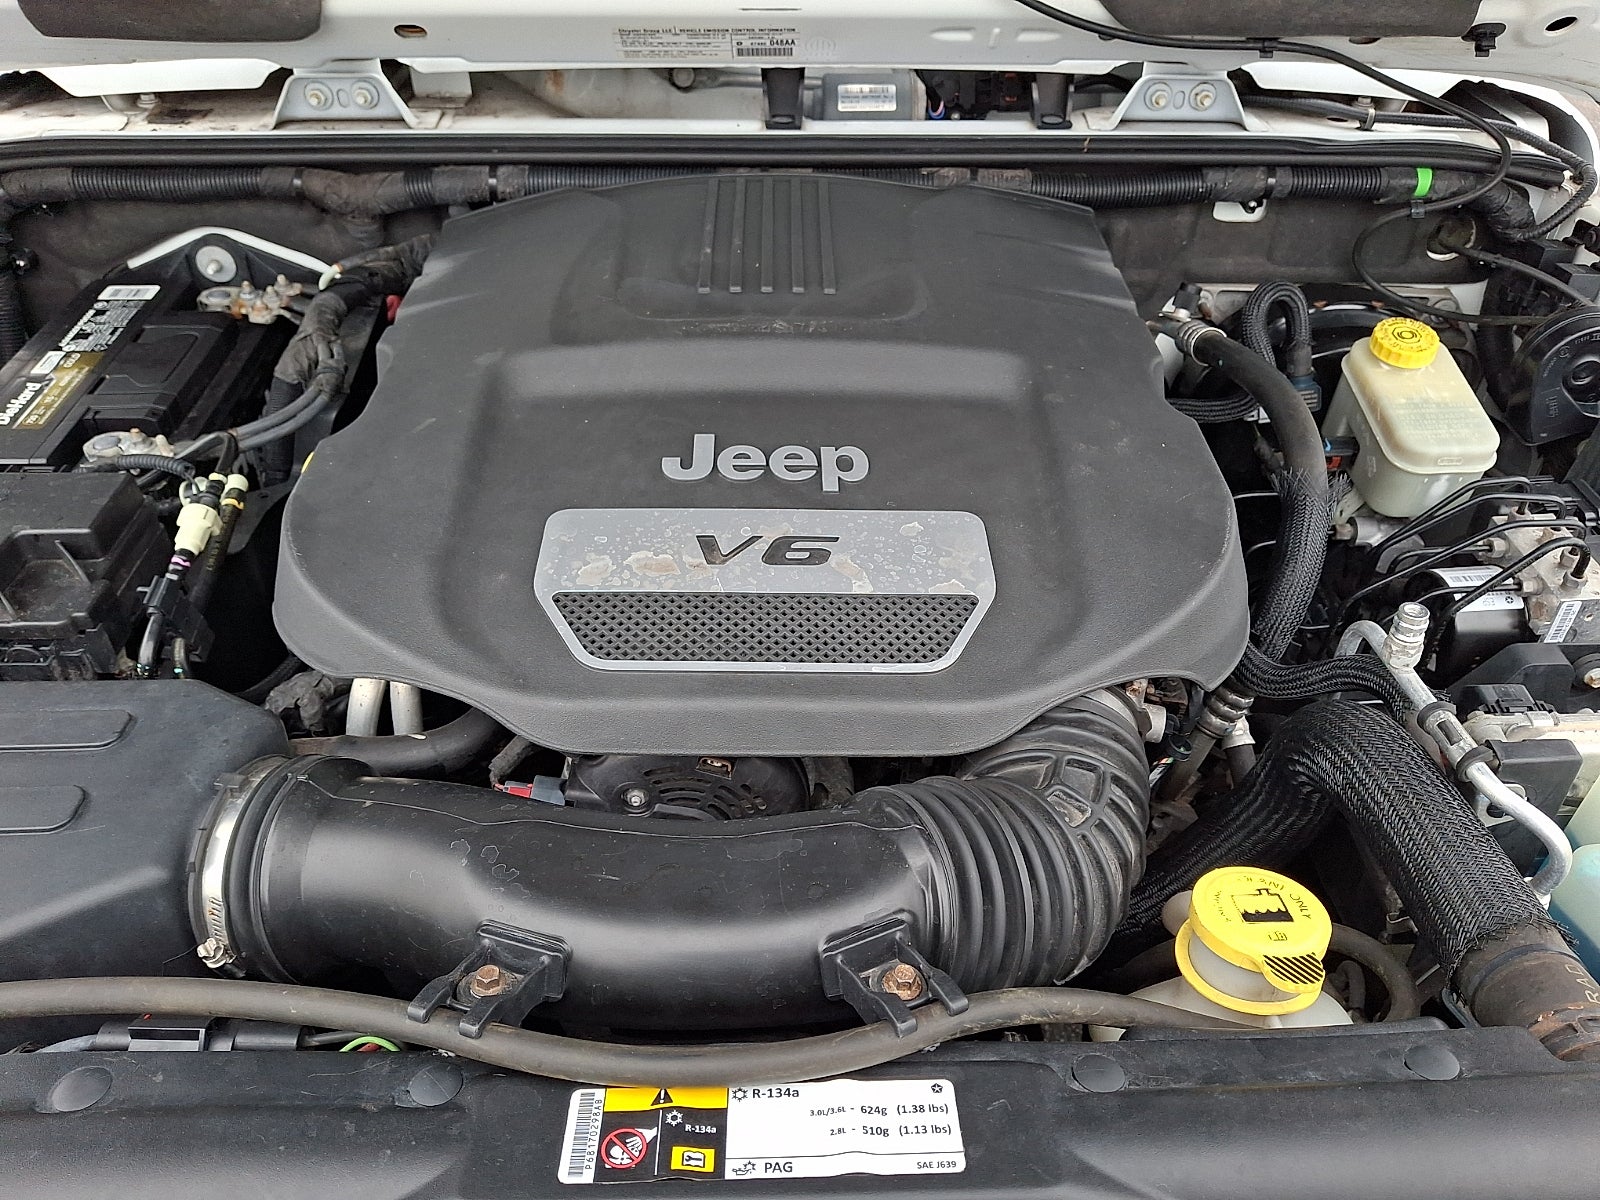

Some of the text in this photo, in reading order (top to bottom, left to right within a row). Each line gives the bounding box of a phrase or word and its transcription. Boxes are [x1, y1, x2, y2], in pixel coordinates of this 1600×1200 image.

[661, 432, 871, 493] Jeep
[694, 534, 841, 566] V6
[752, 1086, 800, 1100] R-134a
[809, 1106, 847, 1117] 3.0L/3.6L
[860, 1105, 888, 1116] 624g
[896, 1104, 926, 1115] (1.38
[928, 1103, 949, 1115] lbs)
[684, 1124, 717, 1134] R-134a
[829, 1127, 847, 1136] 2.8L
[862, 1125, 890, 1137] 510g
[898, 1125, 928, 1136] (1.13
[930, 1124, 952, 1135] lbs)
[763, 1162, 793, 1174] PAG
[916, 1160, 957, 1169] SAE J639
